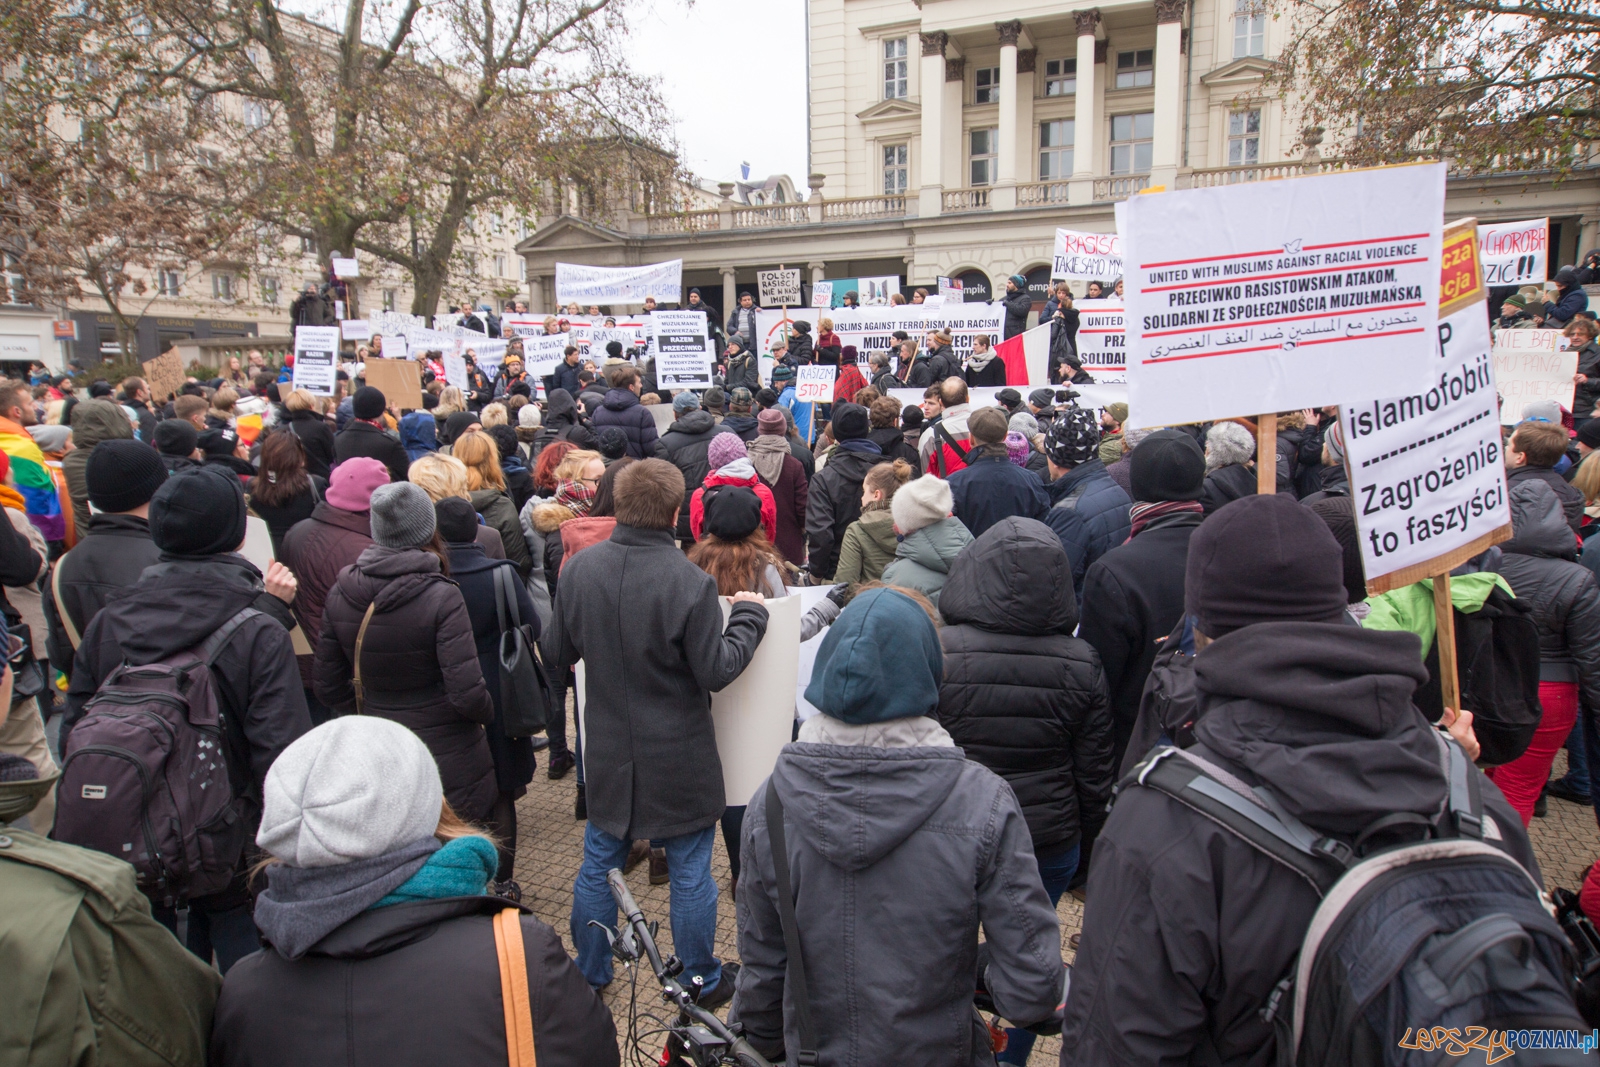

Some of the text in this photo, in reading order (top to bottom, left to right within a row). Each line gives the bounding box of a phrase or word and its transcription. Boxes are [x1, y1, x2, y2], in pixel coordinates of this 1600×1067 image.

[1064, 234, 1123, 256] RASIŚC
[1486, 227, 1546, 256] CHOROBA
[1150, 243, 1418, 284] UNITED WITH MUSLIMS AGAINST RACIAL VIOLENCE
[761, 271, 796, 281] POLSCY
[762, 288, 775, 297] NIE
[963, 283, 986, 296] mpik
[1028, 283, 1058, 294] empk
[1169, 268, 1398, 307] PRZECIWKO RASISTOWSKIM ATAKOM,
[770, 295, 796, 305] IMIENIU
[1087, 316, 1124, 326] UNITED
[1143, 310, 1210, 331] SOLIDARNI
[1212, 307, 1226, 322] ZE
[1228, 296, 1327, 321] SPOŁECZNOŚCIĄ
[1367, 310, 1418, 333] متحدون
[834, 321, 862, 332] USLIMS
[864, 320, 897, 331] AGAINST
[947, 319, 965, 329] AND
[967, 318, 999, 329] RACISM
[1259, 325, 1284, 342] ضد
[1289, 317, 1341, 341] المسلمين
[1345, 322, 1363, 338] مع
[593, 330, 632, 342] RASIZM
[1216, 328, 1255, 347] العنف
[1495, 329, 1524, 349] NIE
[798, 383, 828, 397] STOP
[1349, 353, 1490, 440] islamofobii
[1361, 440, 1498, 516] Zagrożenie
[1369, 478, 1503, 557] to faszyści
